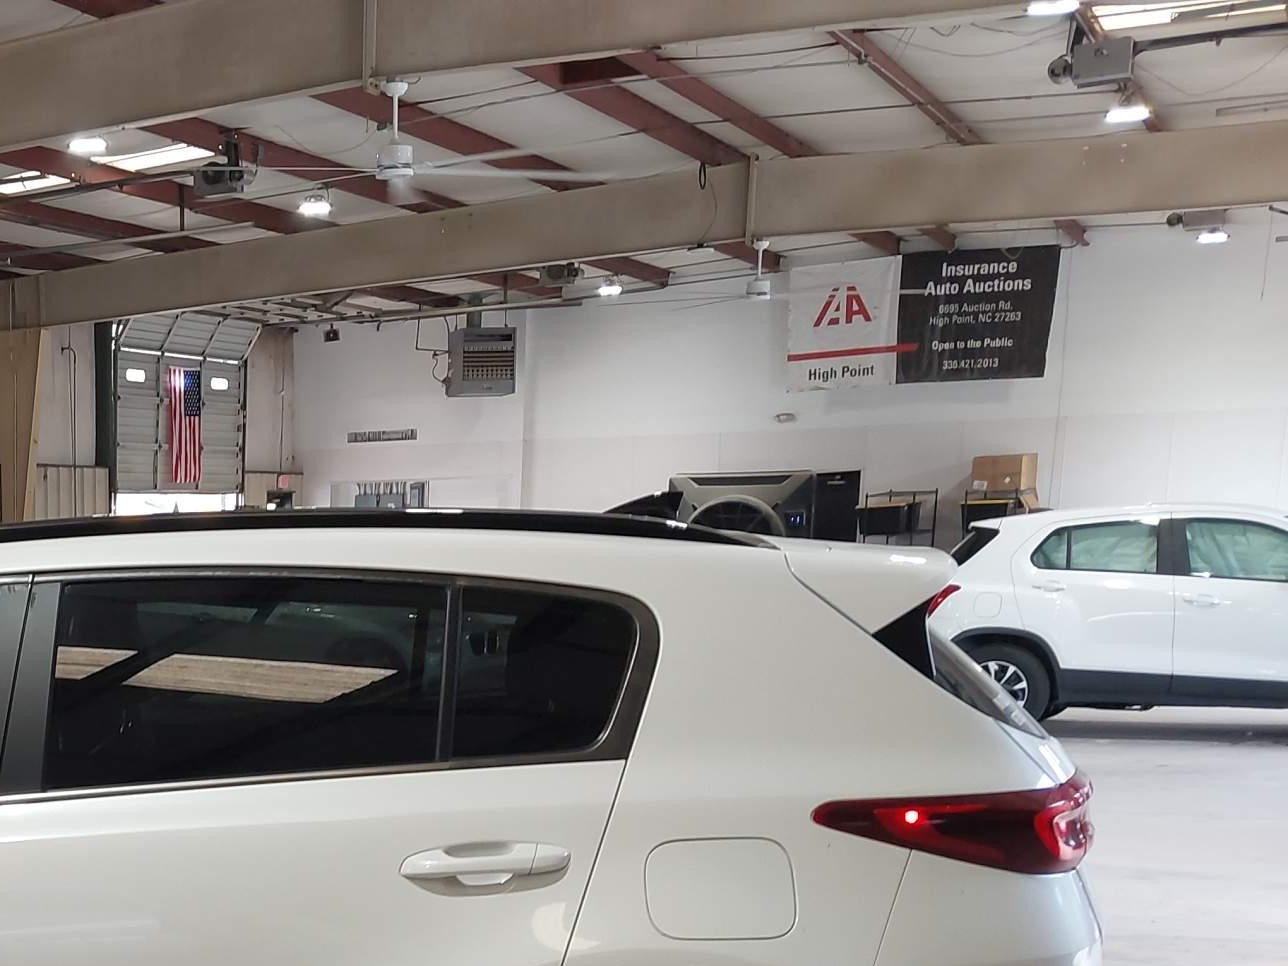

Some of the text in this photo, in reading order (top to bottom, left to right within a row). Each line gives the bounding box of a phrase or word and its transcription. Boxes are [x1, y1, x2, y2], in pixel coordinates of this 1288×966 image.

[942, 261, 1018, 276] Insurance
[924, 277, 1032, 296] Auto Auctions
[961, 302, 996, 312] Auction
[929, 315, 949, 327] High
[978, 312, 992, 323] NC
[931, 337, 1013, 352] Open to the Public
[808, 365, 874, 382] High Point
